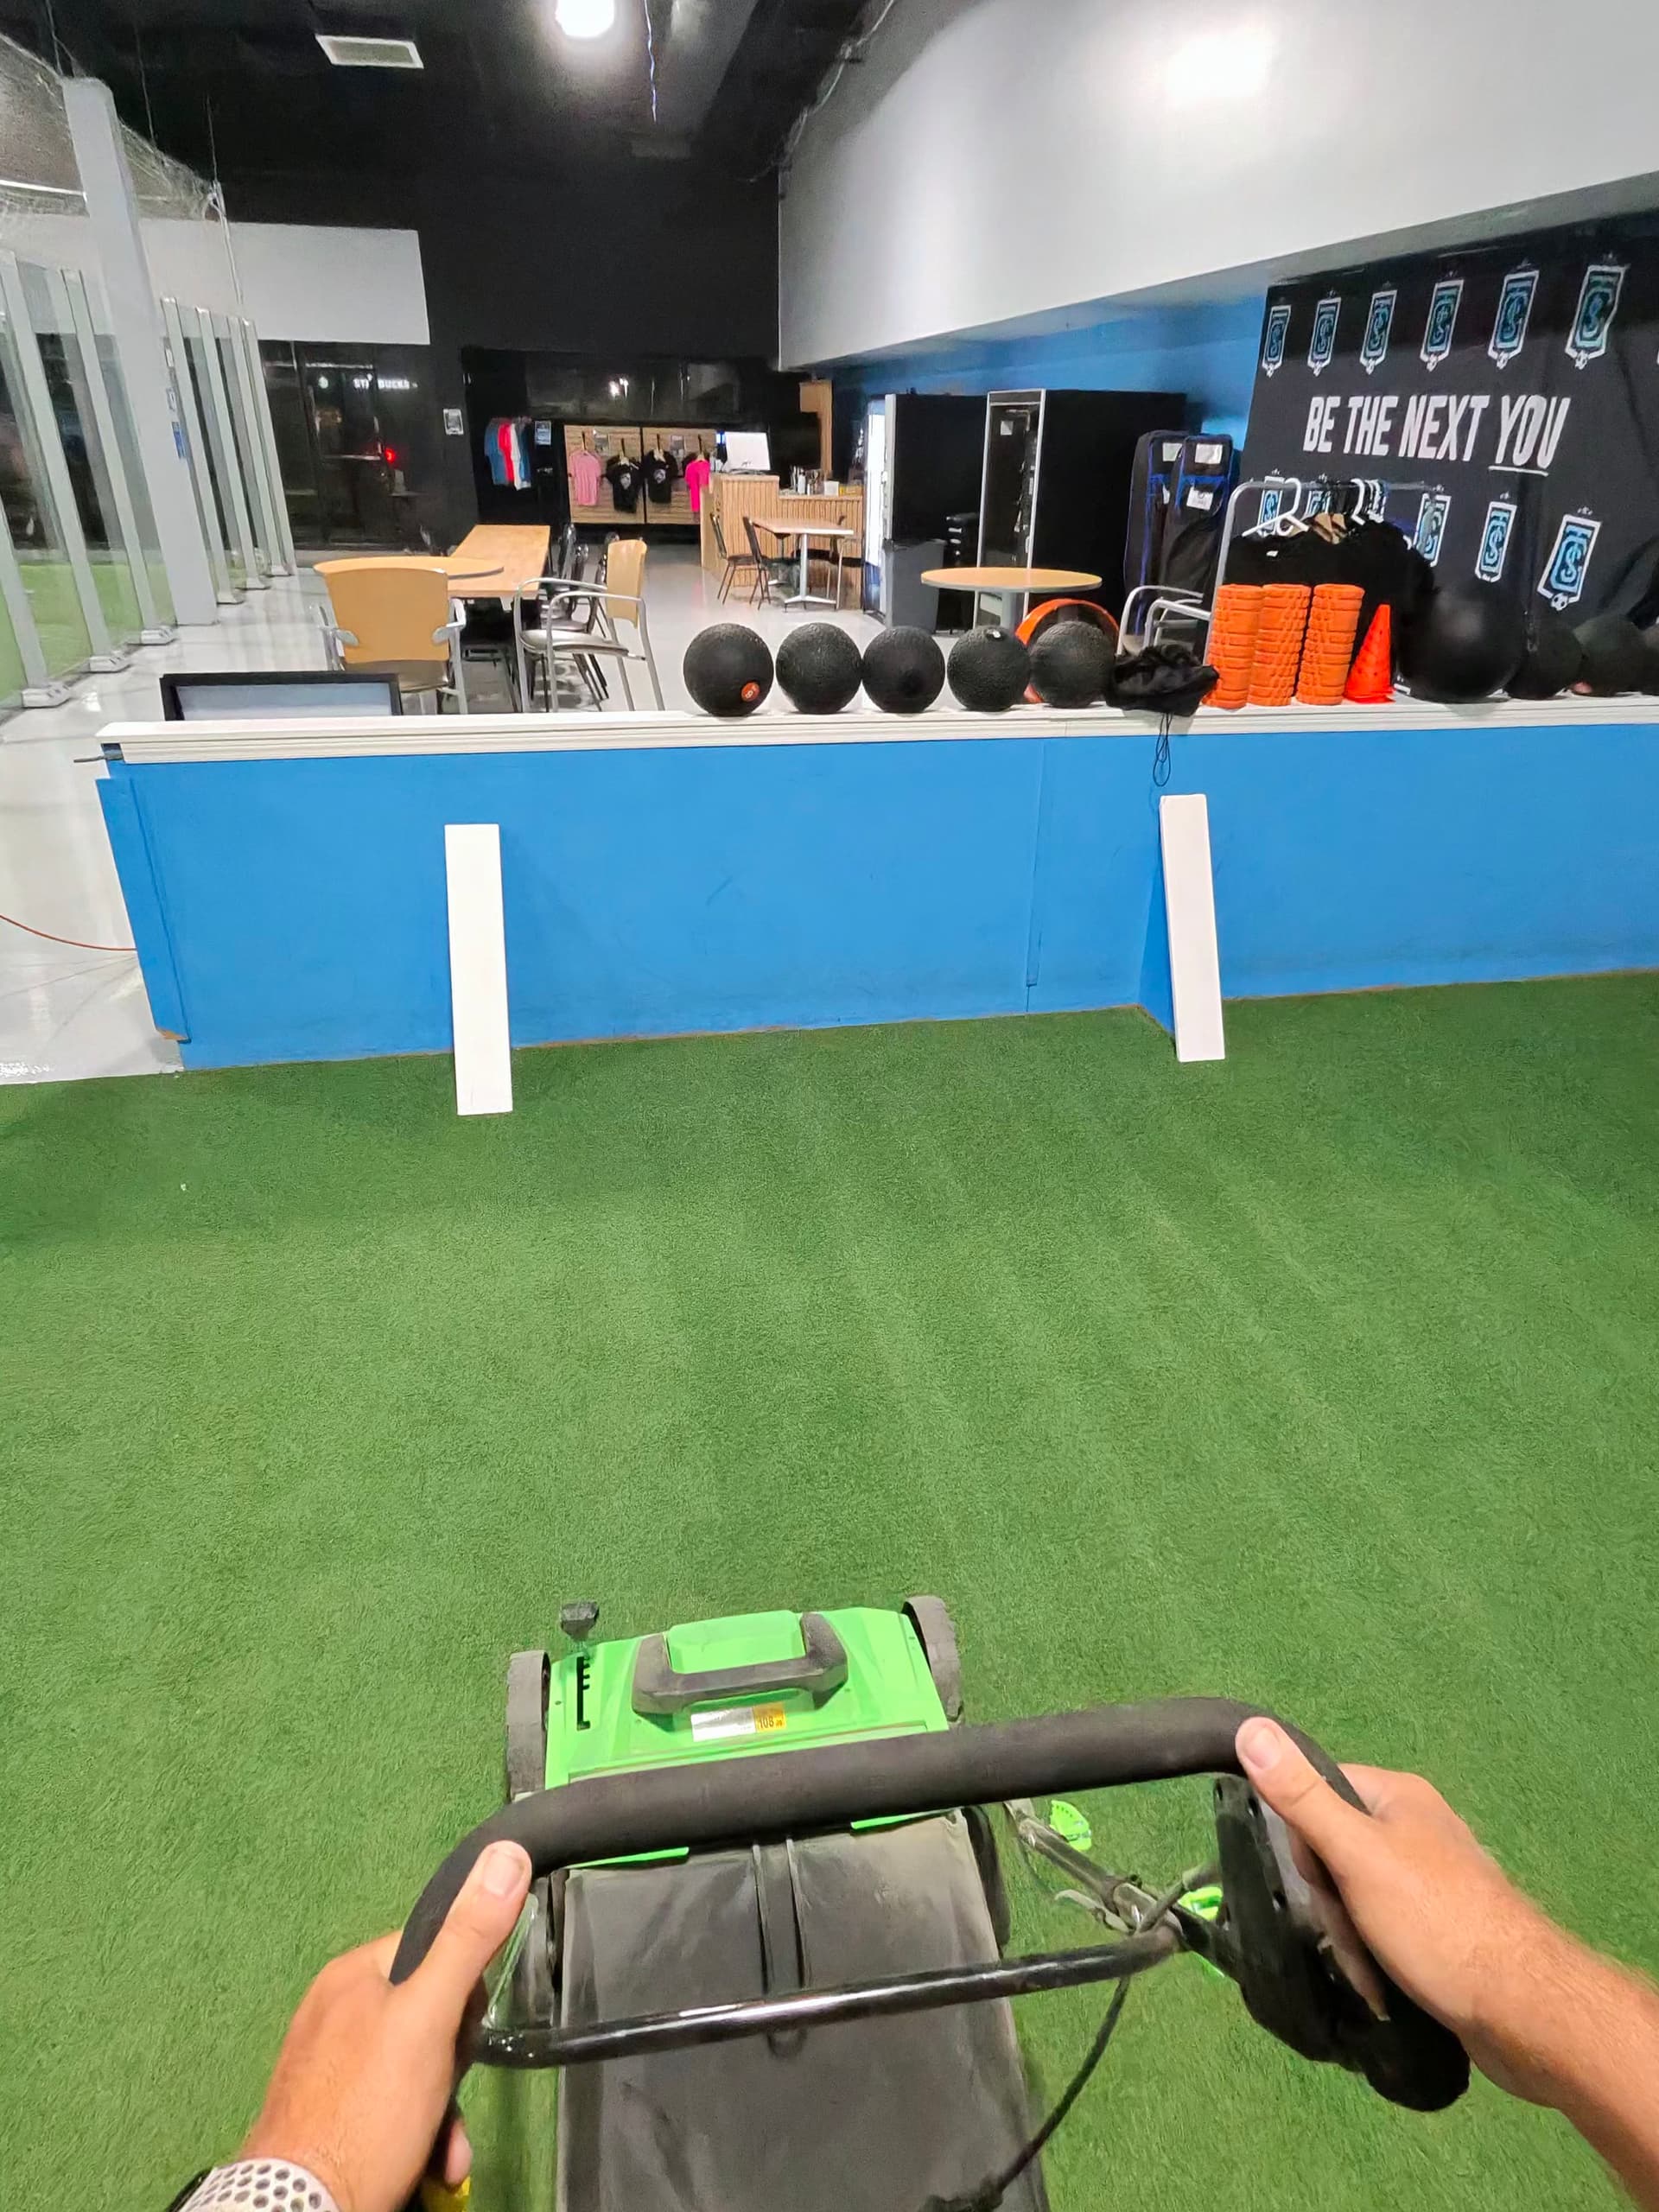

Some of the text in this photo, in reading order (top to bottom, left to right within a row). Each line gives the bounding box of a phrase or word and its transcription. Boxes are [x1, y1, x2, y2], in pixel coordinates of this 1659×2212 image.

[1302, 394, 1572, 469] BE THE NEXT YOU
